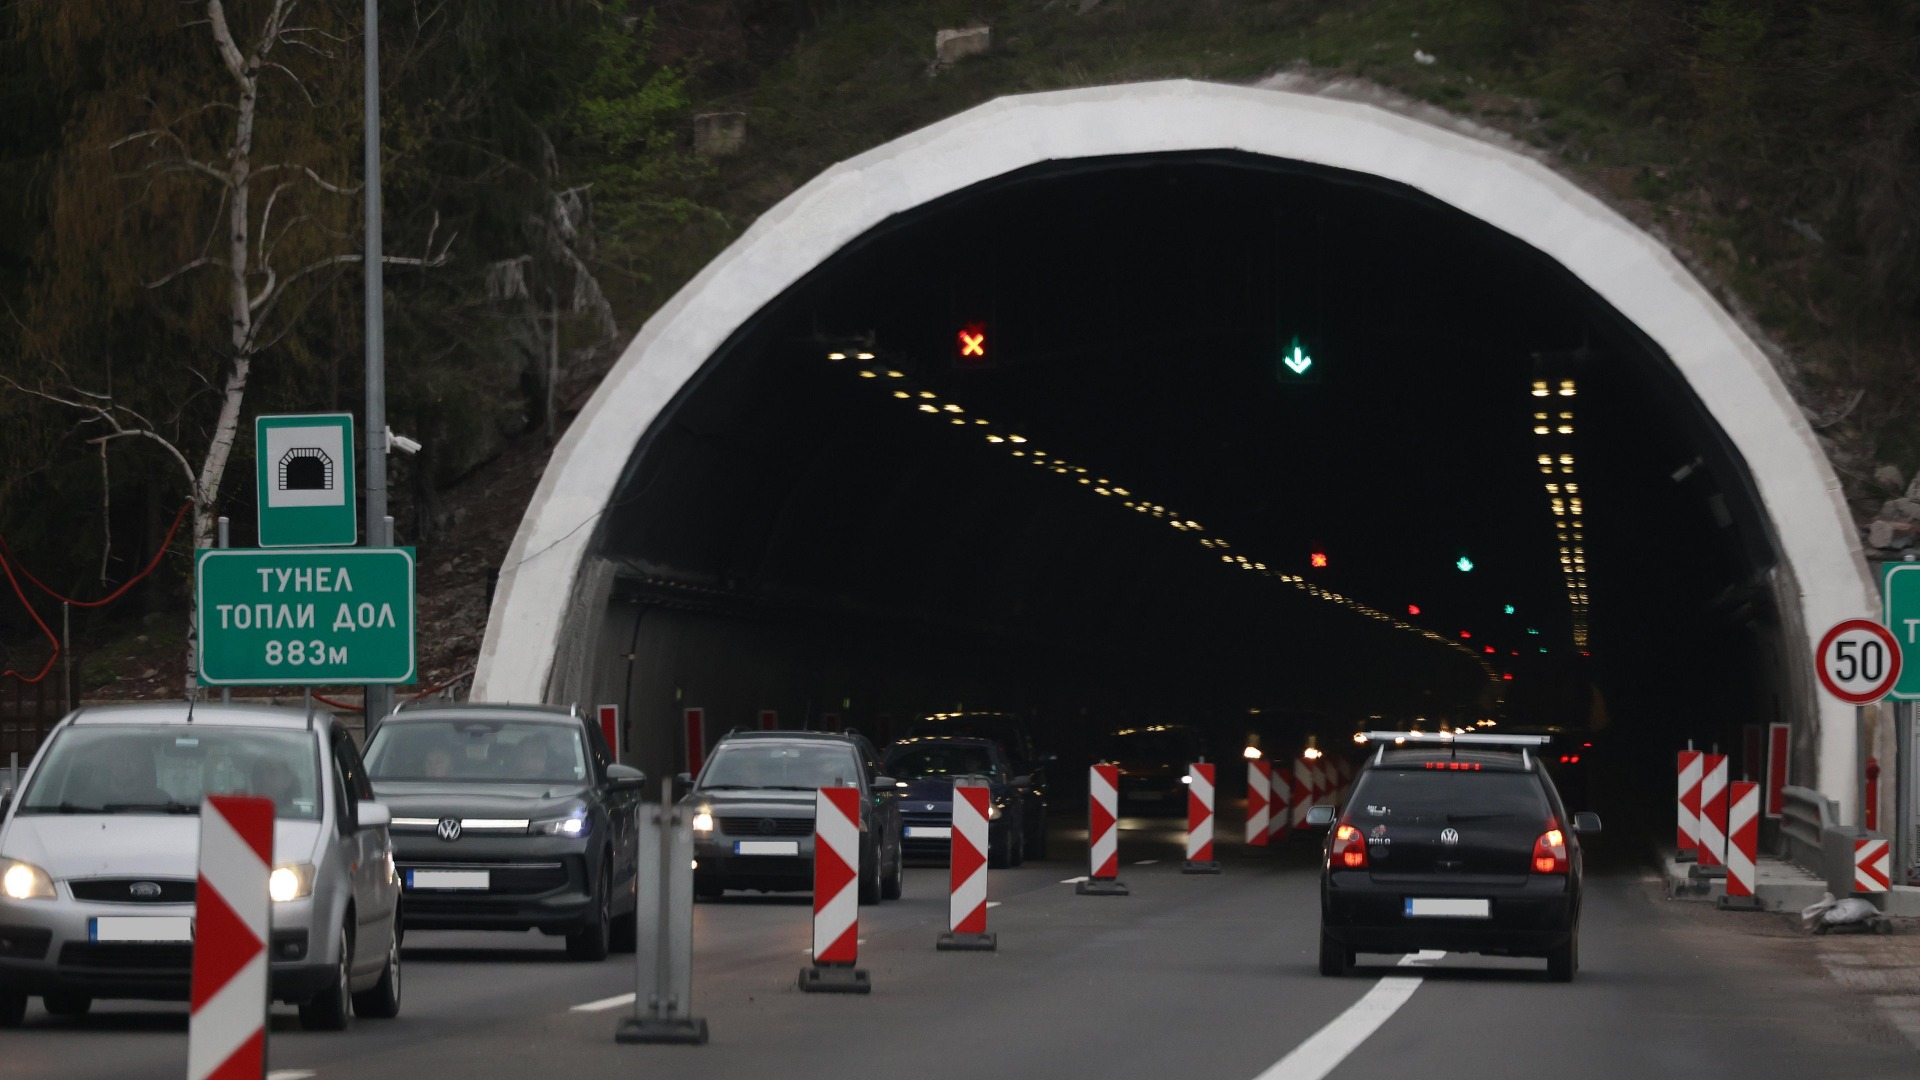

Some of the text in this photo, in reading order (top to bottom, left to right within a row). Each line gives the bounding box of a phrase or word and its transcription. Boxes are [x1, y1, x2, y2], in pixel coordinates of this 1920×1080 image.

[257, 567, 353, 593] ТУНЕЛ
[216, 602, 396, 632] ТОПЛИ ДОЛ
[1836, 641, 1882, 682] 50
